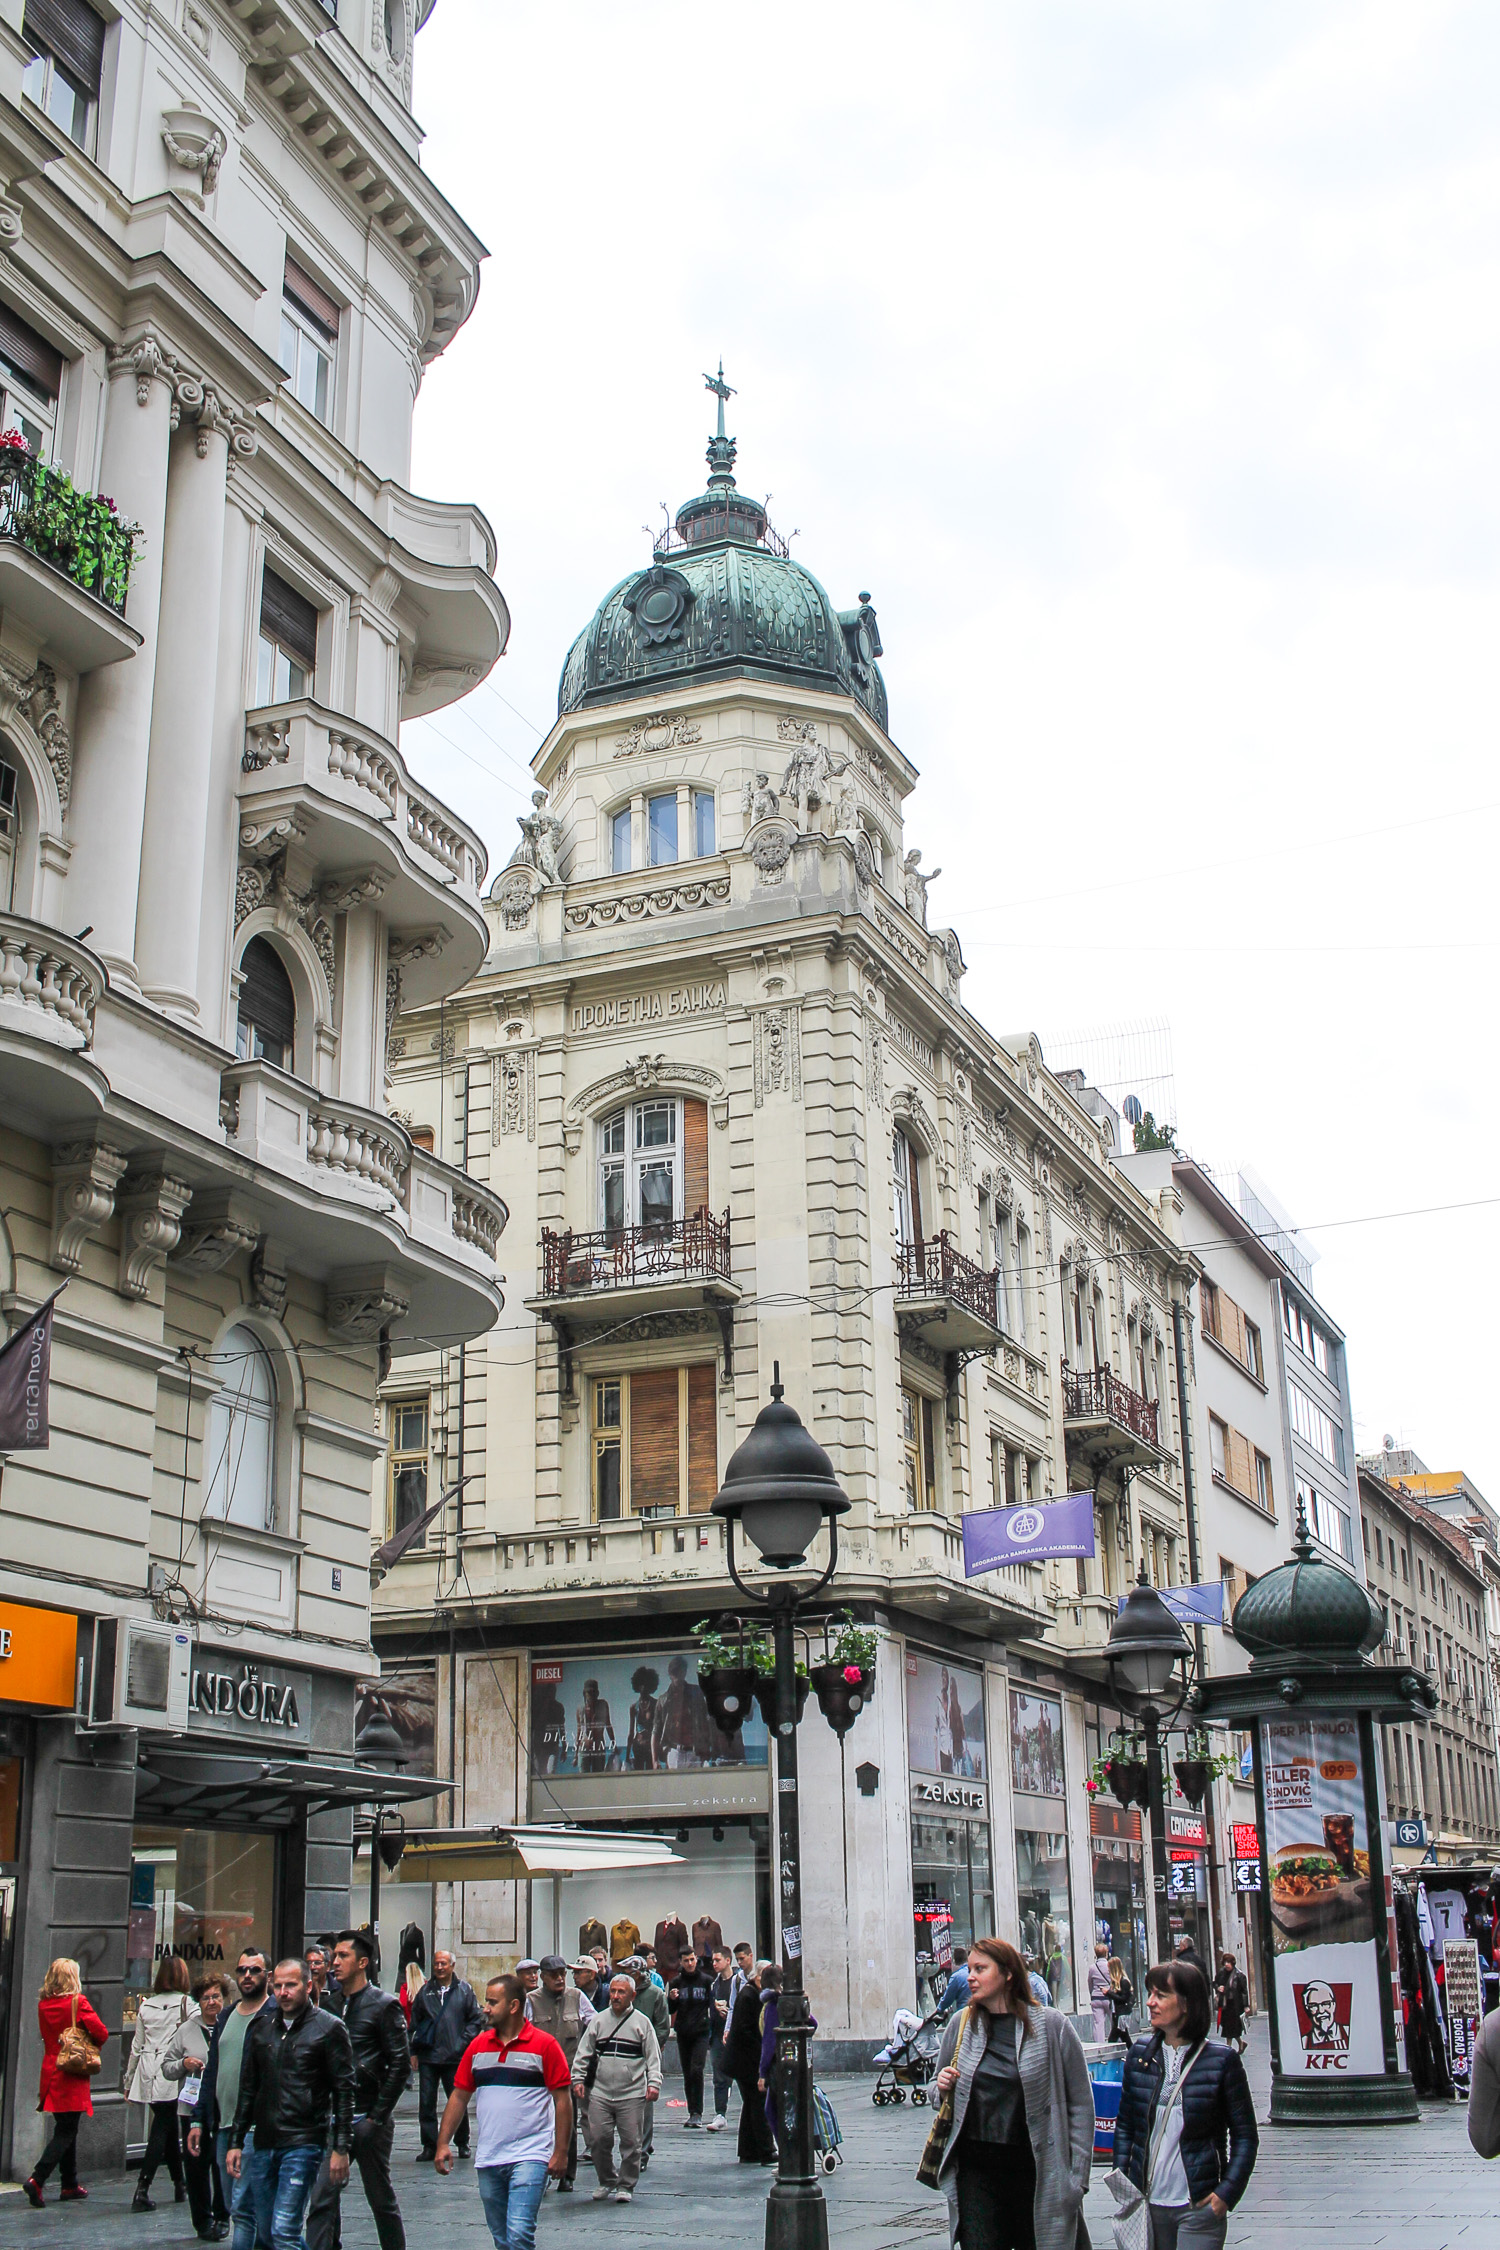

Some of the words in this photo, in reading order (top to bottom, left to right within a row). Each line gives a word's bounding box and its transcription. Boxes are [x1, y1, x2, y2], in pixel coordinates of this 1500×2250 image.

[571, 993, 663, 1031] ПРОМЕТНА
[668, 983, 727, 1016] БАНКА
[971, 1553, 1009, 1568] BEOGRADSKA
[1010, 1546, 1047, 1558] BANKARSKA
[1049, 1544, 1086, 1552] AKADEMIJA
[536, 1667, 562, 1680] DIESEL
[189, 1667, 299, 1727] NDORA
[1262, 1725, 1295, 1738] SUPER
[1299, 1722, 1356, 1736] PONUDA
[1265, 1768, 1311, 1784] FILLER
[1323, 1765, 1345, 1777] 199
[922, 1781, 985, 1808] zekstra
[1266, 1782, 1312, 1799] SENDVIČ
[692, 1795, 757, 1805] zekstra
[1170, 1815, 1202, 1839] CONVERSE
[1440, 1909, 1450, 1929] 7
[154, 1942, 225, 1961] PANDORA
[1304, 2053, 1350, 2070] KFC
